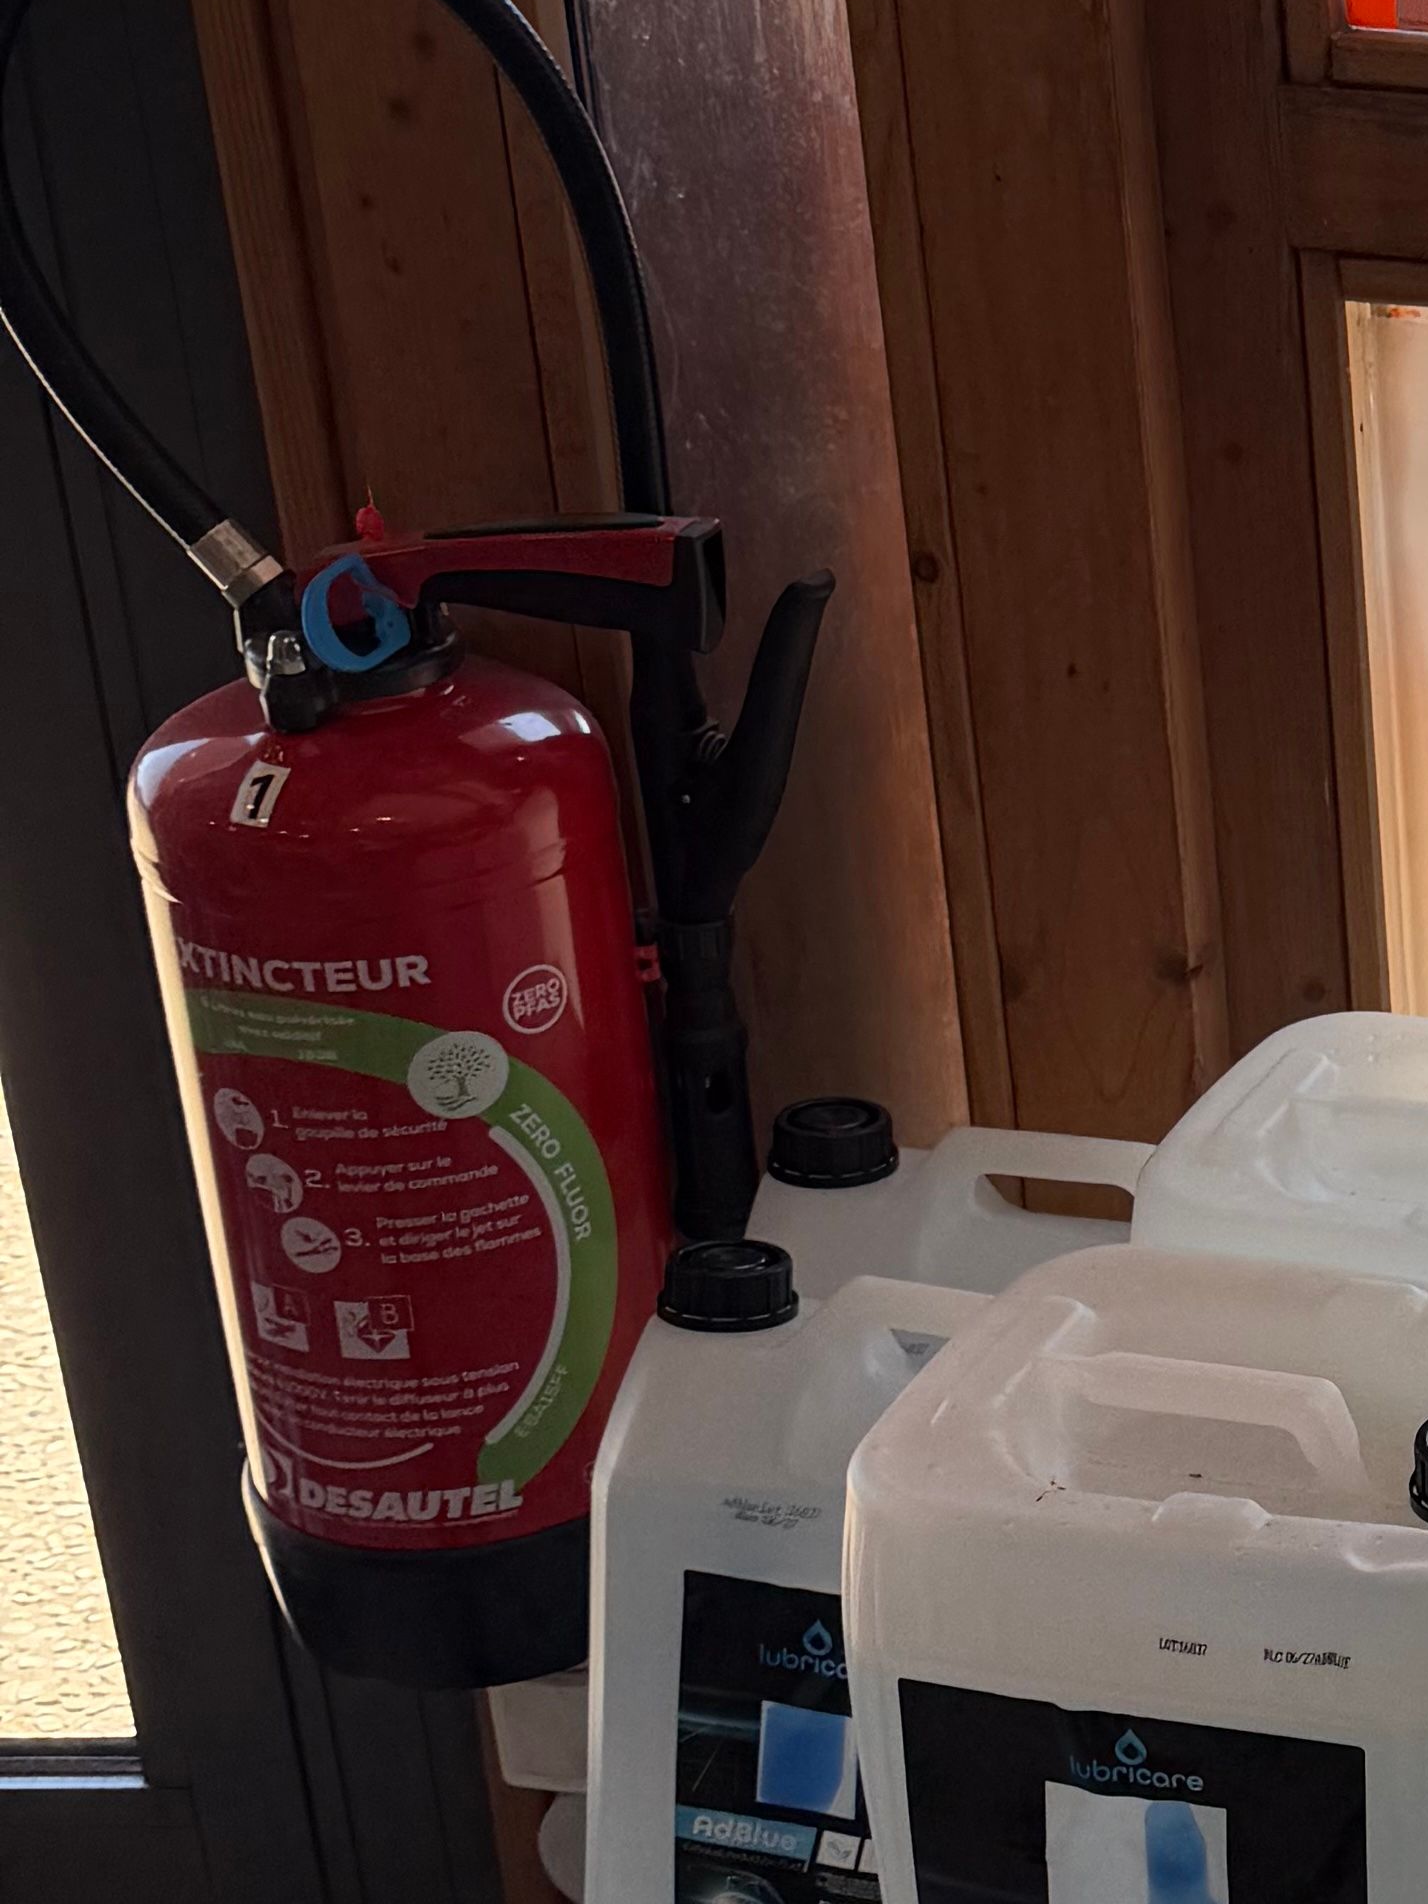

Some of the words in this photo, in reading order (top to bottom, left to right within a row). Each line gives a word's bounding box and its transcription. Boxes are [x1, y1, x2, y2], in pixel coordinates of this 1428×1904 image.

[247, 770, 275, 820] 1
[177, 936, 433, 993] XTINCTEUR
[510, 977, 561, 1007] ZERO
[512, 995, 562, 1022] PFAS
[334, 1161, 405, 1179] Appuyer
[336, 1180, 383, 1195] levier
[406, 1162, 500, 1191] commande
[506, 1102, 562, 1161] ZERO
[552, 1162, 594, 1243] FLUOR
[375, 1213, 439, 1231] Presser
[400, 1227, 453, 1248] diriger
[399, 1247, 441, 1264] base
[441, 1242, 473, 1260] des
[474, 1226, 543, 1254] flammes
[379, 1302, 400, 1326] B
[461, 1359, 521, 1382] tension
[299, 1477, 525, 1523] DESAUTEL
[1069, 1754, 1206, 1795] lubricare
[692, 1814, 799, 1852] AdBlue
